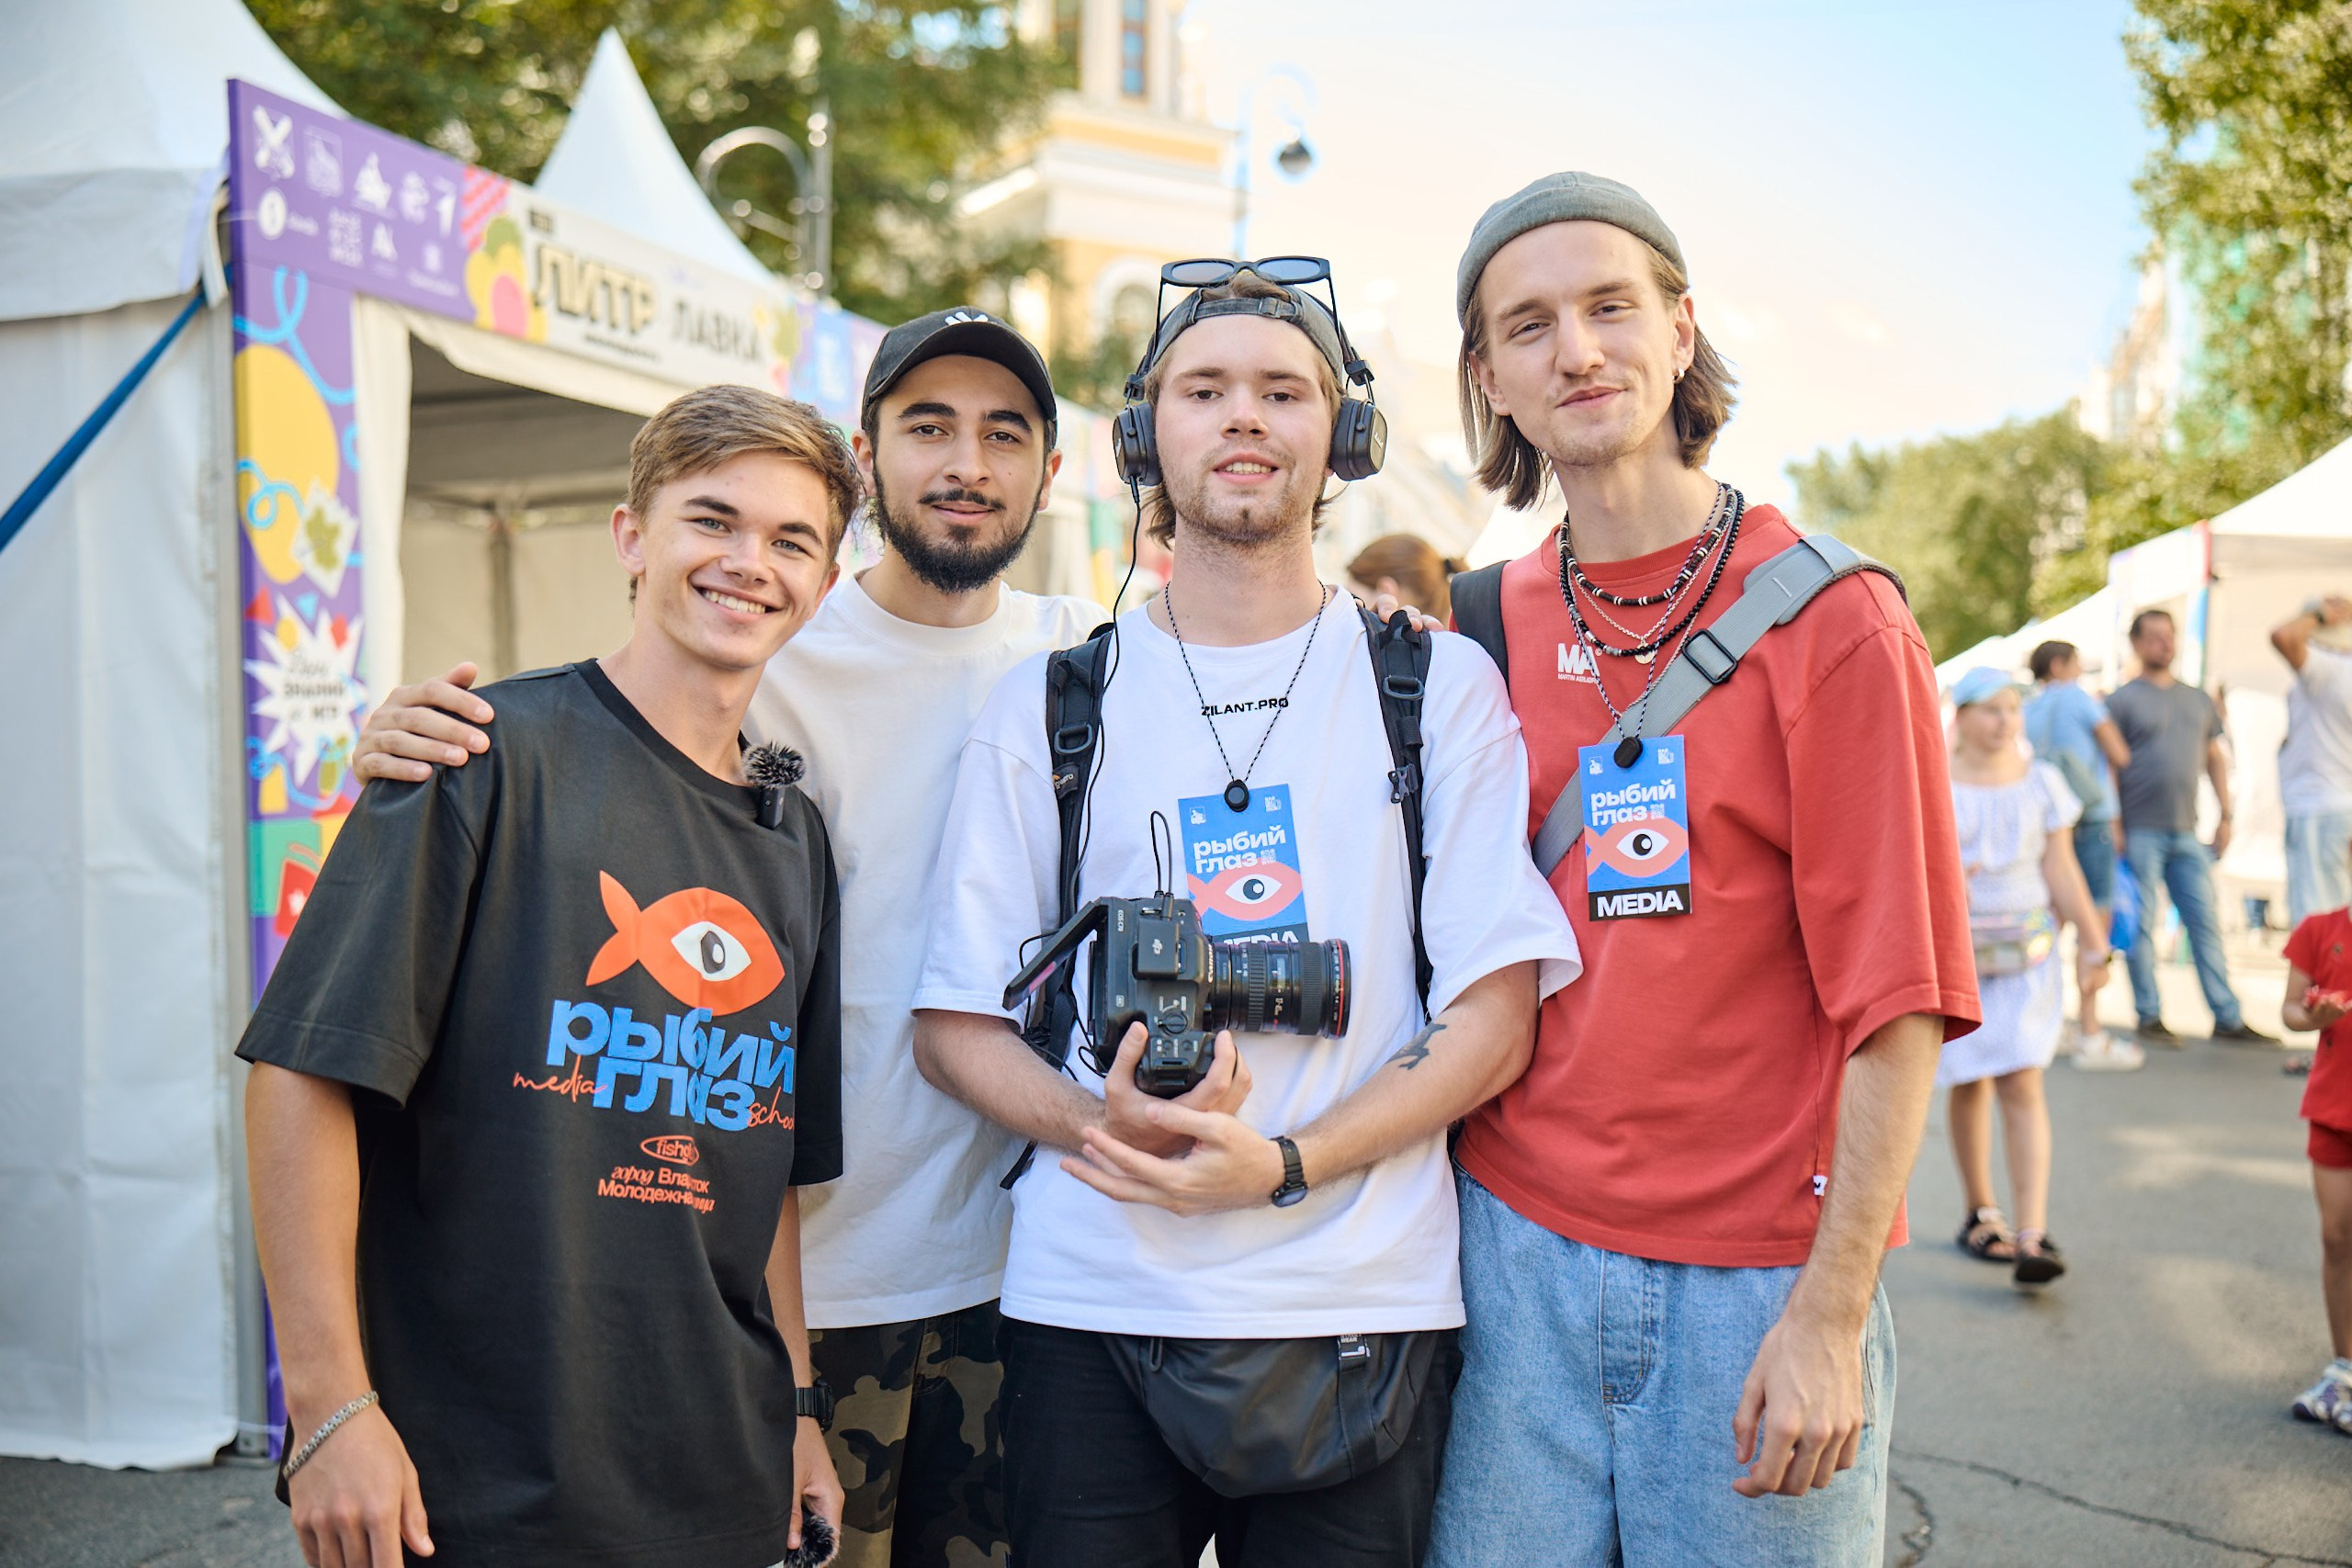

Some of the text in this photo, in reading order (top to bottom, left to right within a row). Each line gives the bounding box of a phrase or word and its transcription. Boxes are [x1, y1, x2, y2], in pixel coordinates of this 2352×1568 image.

[1201, 697, 1289, 716] ZILANT.PRO
[1590, 779, 1676, 812] рыбий
[1591, 804, 1648, 827] глаз
[1193, 825, 1286, 861] рыбий
[1195, 852, 1258, 874] глаз
[1596, 889, 1684, 918] MEDIA
[547, 999, 795, 1094] рыбий
[513, 1054, 608, 1103] media
